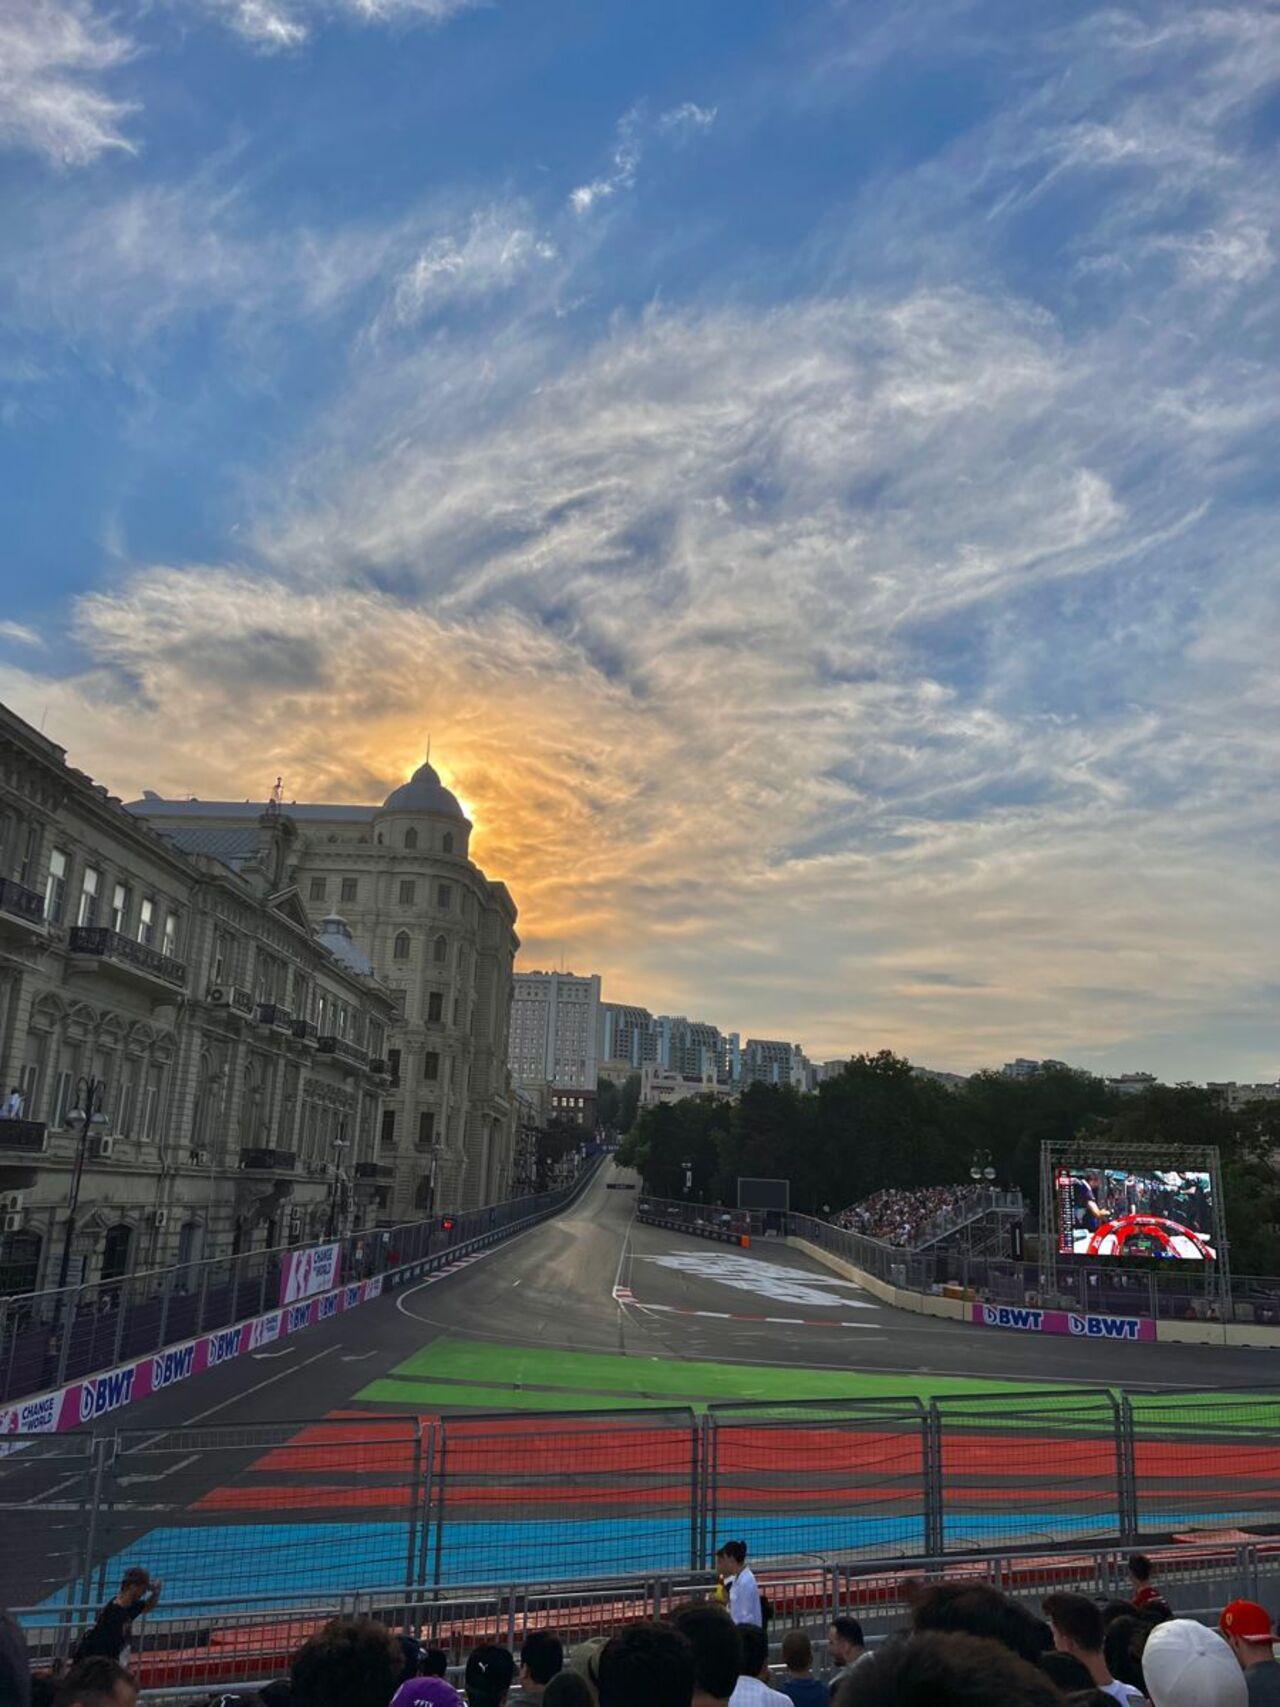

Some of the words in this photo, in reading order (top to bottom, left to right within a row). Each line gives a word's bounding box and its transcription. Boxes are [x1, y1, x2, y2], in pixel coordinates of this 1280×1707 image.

[293, 1304, 311, 1328] BWT
[999, 1308, 1042, 1329] BWT
[1086, 1317, 1138, 1338] BWT
[217, 1329, 241, 1360] BWT
[163, 1345, 194, 1382] BWT
[95, 1369, 135, 1413] BWT
[22, 1397, 55, 1420] CHANGE
[27, 1412, 54, 1431] WORLD
